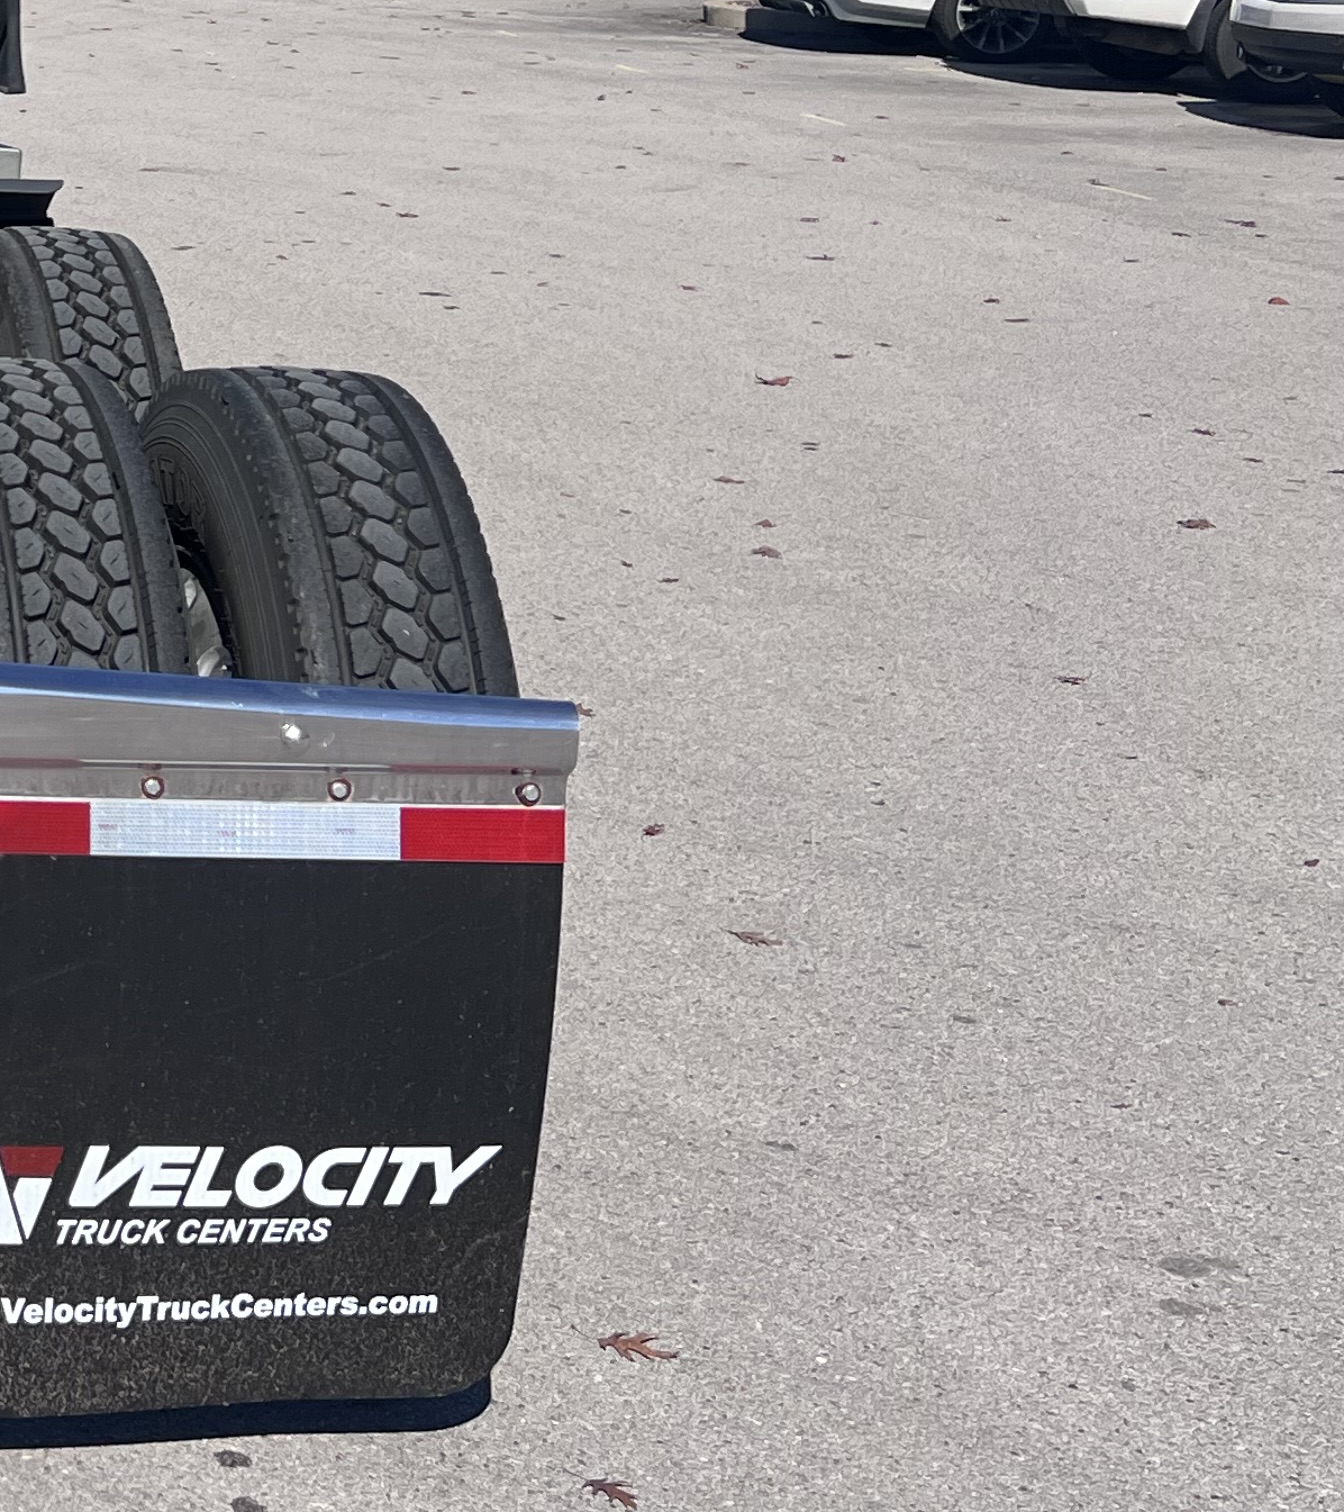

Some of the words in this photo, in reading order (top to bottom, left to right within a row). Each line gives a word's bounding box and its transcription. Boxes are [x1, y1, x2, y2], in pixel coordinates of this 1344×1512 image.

[69, 1145, 502, 1207] VELOCITY
[56, 1219, 167, 1246] TRUCK
[176, 1218, 332, 1244] CENTERS
[1, 1292, 438, 1328] VelocityTruckCenters.com
